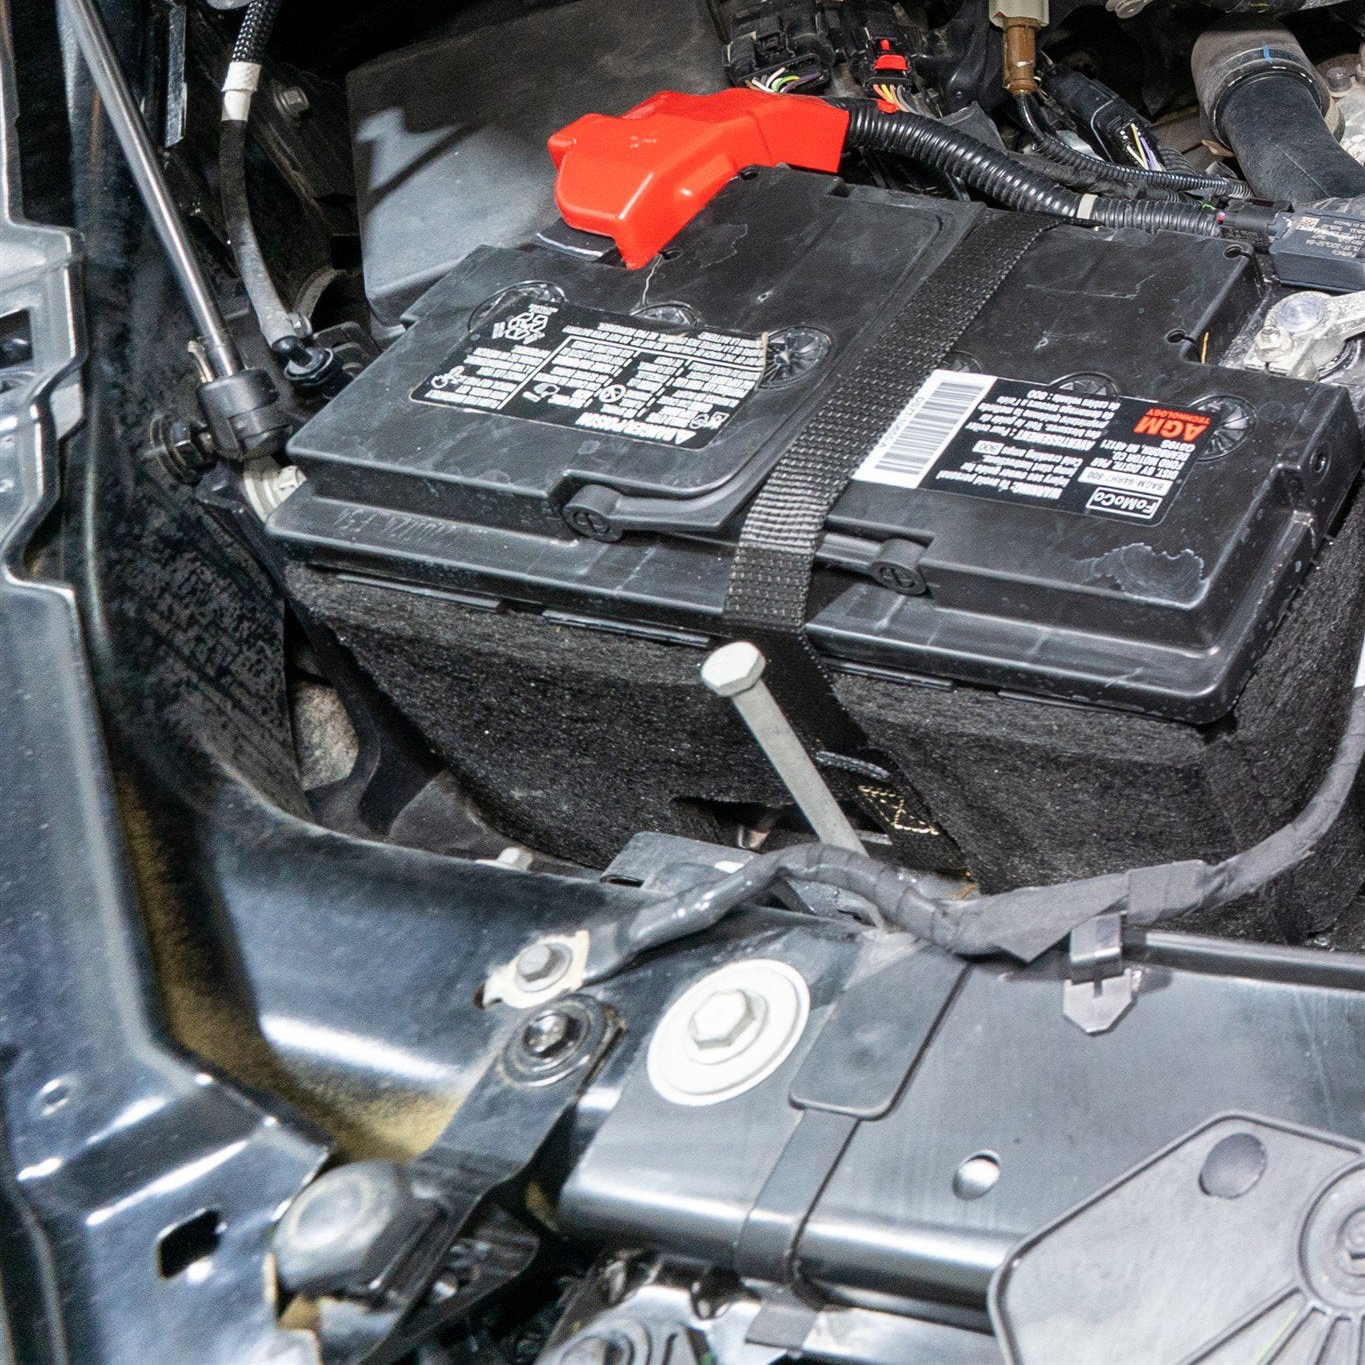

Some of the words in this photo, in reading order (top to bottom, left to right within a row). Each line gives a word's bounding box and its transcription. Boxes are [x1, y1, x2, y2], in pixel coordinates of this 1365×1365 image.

[1025, 389, 1049, 399] 800
[1145, 407, 1212, 424] TECHNOLOGY
[1132, 415, 1207, 442] AGM
[1098, 438, 1128, 450] 48121
[1108, 450, 1128, 460] CO.
[1137, 443, 1191, 461] DEARBORN,
[1089, 457, 1112, 468] PAR
[1124, 453, 1159, 466] MOTOR
[1157, 458, 1185, 470] FORD
[1139, 465, 1155, 475] BY
[1153, 468, 1179, 479] DIST.
[1089, 491, 1157, 513] FoMoCo
